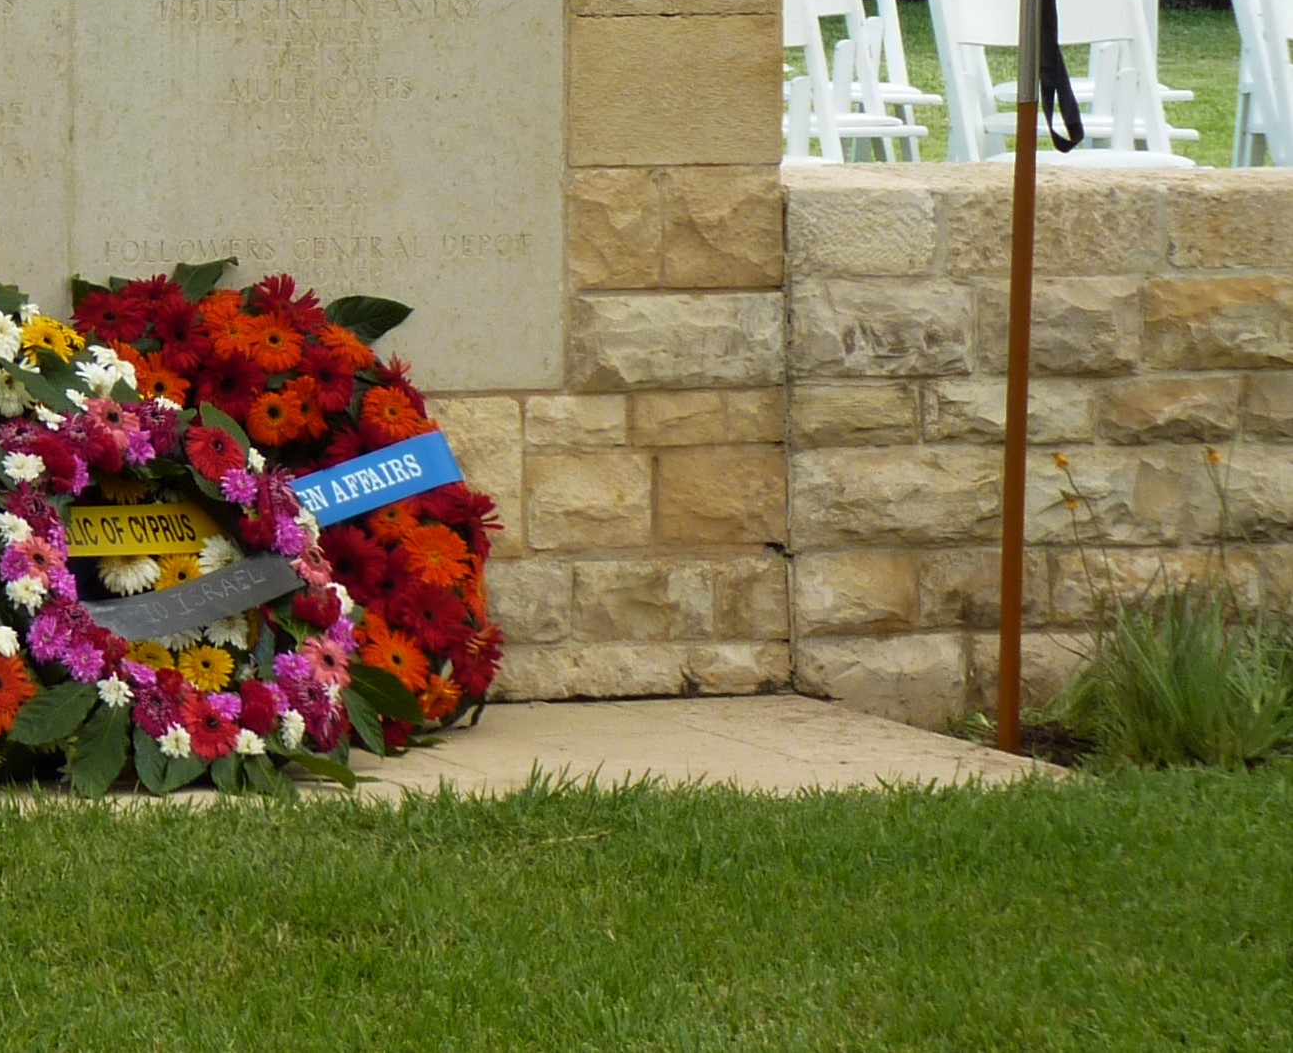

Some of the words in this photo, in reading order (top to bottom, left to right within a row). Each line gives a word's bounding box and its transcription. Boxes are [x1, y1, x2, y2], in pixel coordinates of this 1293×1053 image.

[228, 76, 311, 103] MULE
[325, 76, 416, 102] CORPS
[105, 237, 276, 263] FOLLOWERS
[293, 234, 428, 261] CENTRAL
[442, 232, 533, 259] DEPOT
[331, 453, 423, 504] AFFAIRS
[100, 516, 124, 545] OF
[128, 513, 196, 544] CYPRUS
[170, 568, 268, 617] ISRAEL
